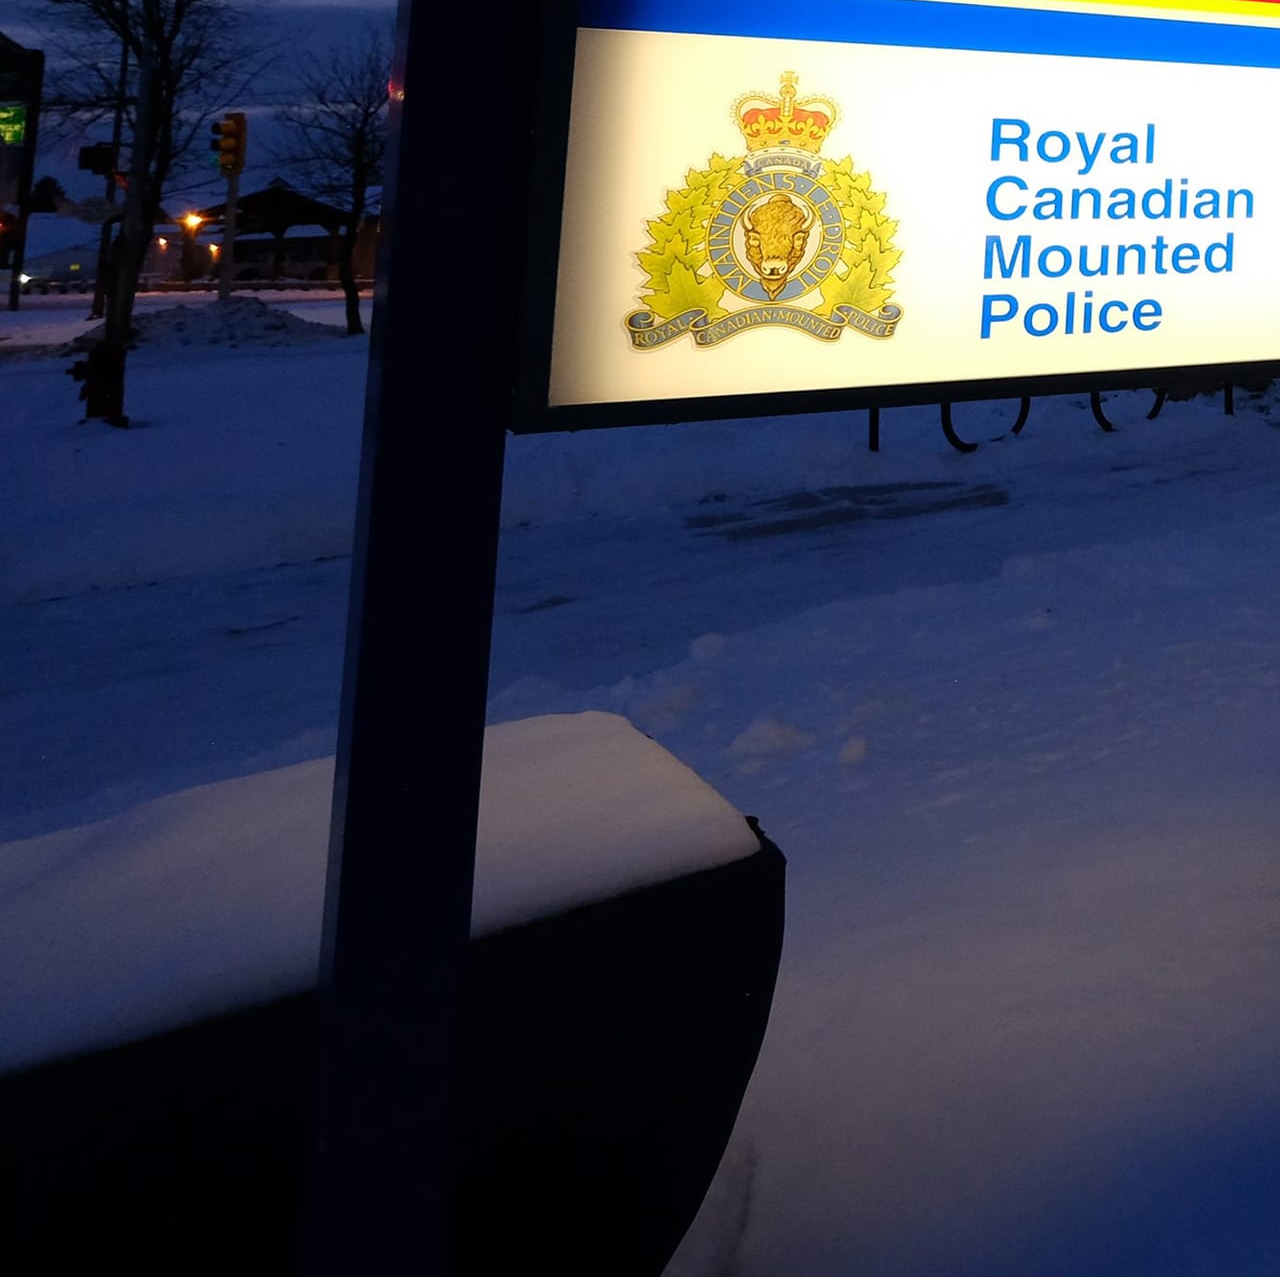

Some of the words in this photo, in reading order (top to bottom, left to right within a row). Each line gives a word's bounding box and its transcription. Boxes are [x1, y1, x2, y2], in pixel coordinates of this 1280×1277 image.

[755, 156, 811, 171] CANADA
[991, 117, 1156, 175] Royal
[804, 184, 836, 215] LE
[985, 175, 1255, 221] Canadian
[708, 175, 796, 294] MAINTIENS
[798, 224, 842, 289] DROIT
[982, 232, 1235, 280] Mounted
[634, 318, 685, 345] ROYAL
[696, 310, 772, 345] CANADIAN
[777, 311, 842, 339] MOUNTED
[851, 311, 895, 337] POLICE
[980, 290, 1163, 340] Police
